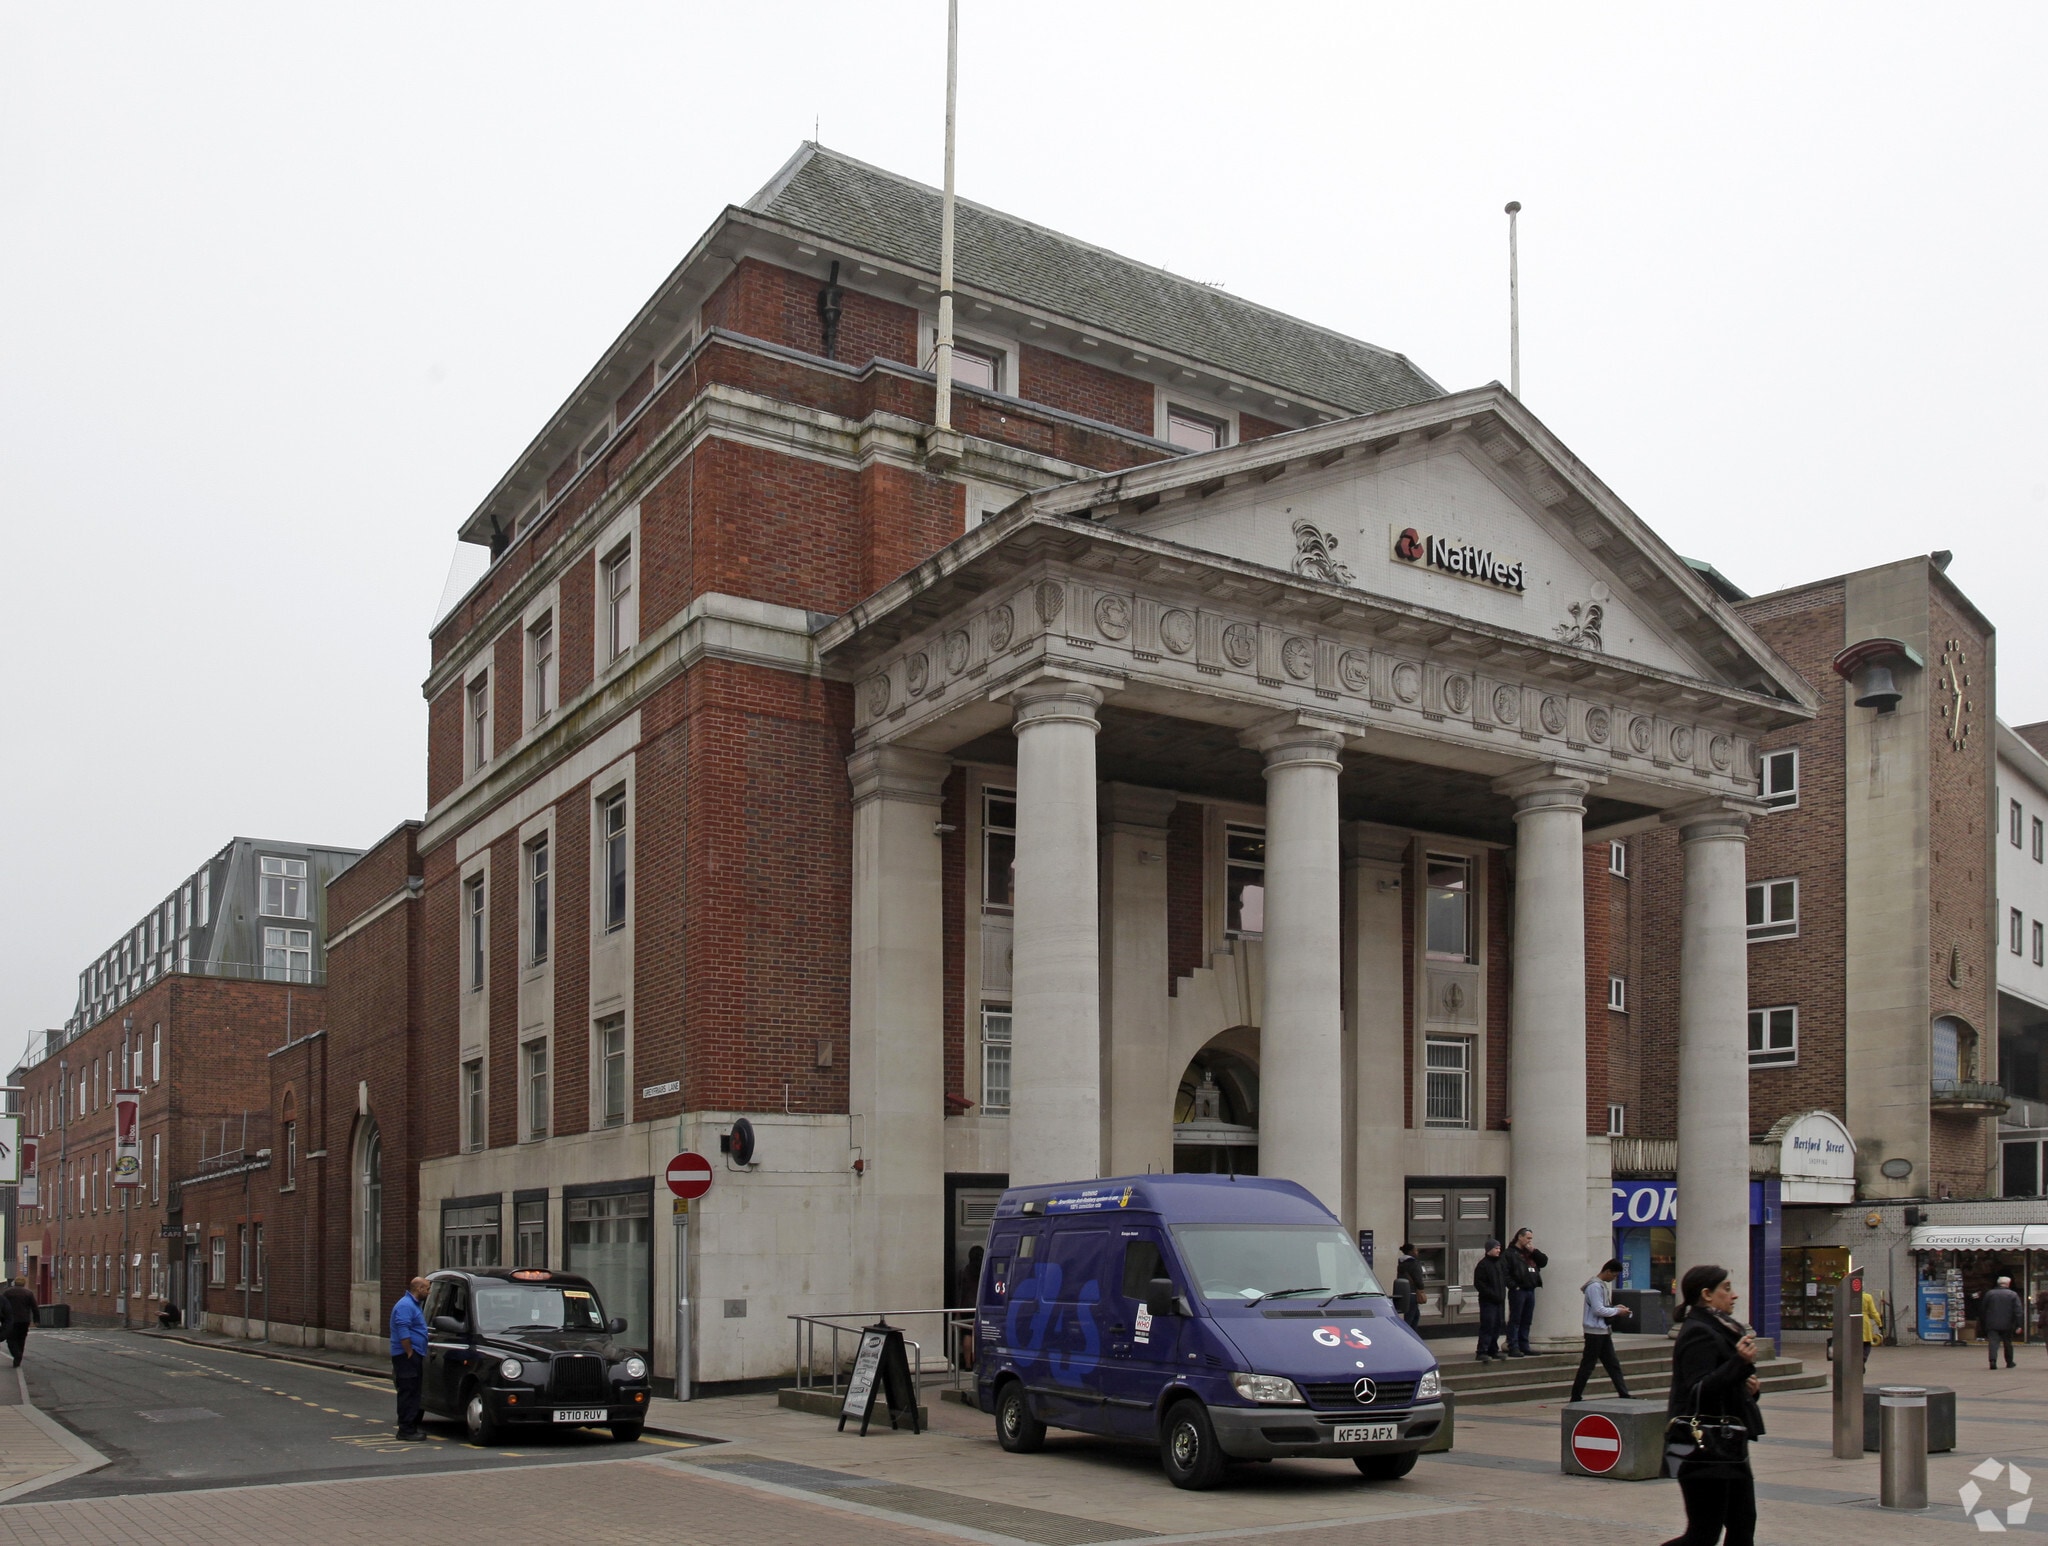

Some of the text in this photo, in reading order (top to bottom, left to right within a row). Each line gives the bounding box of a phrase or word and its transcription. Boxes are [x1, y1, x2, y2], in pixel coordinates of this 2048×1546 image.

[1428, 535, 1528, 590] NatWest
[668, 1082, 679, 1092] LANE
[1793, 1137, 1845, 1153] Hertford Street
[1926, 1235, 2019, 1244] Greetings Cards
[1006, 1262, 1100, 1387] G4S
[1312, 1325, 1372, 1349] G4S
[559, 1410, 602, 1421] BT10 RUV
[1338, 1427, 1393, 1441] KF53 AFX
